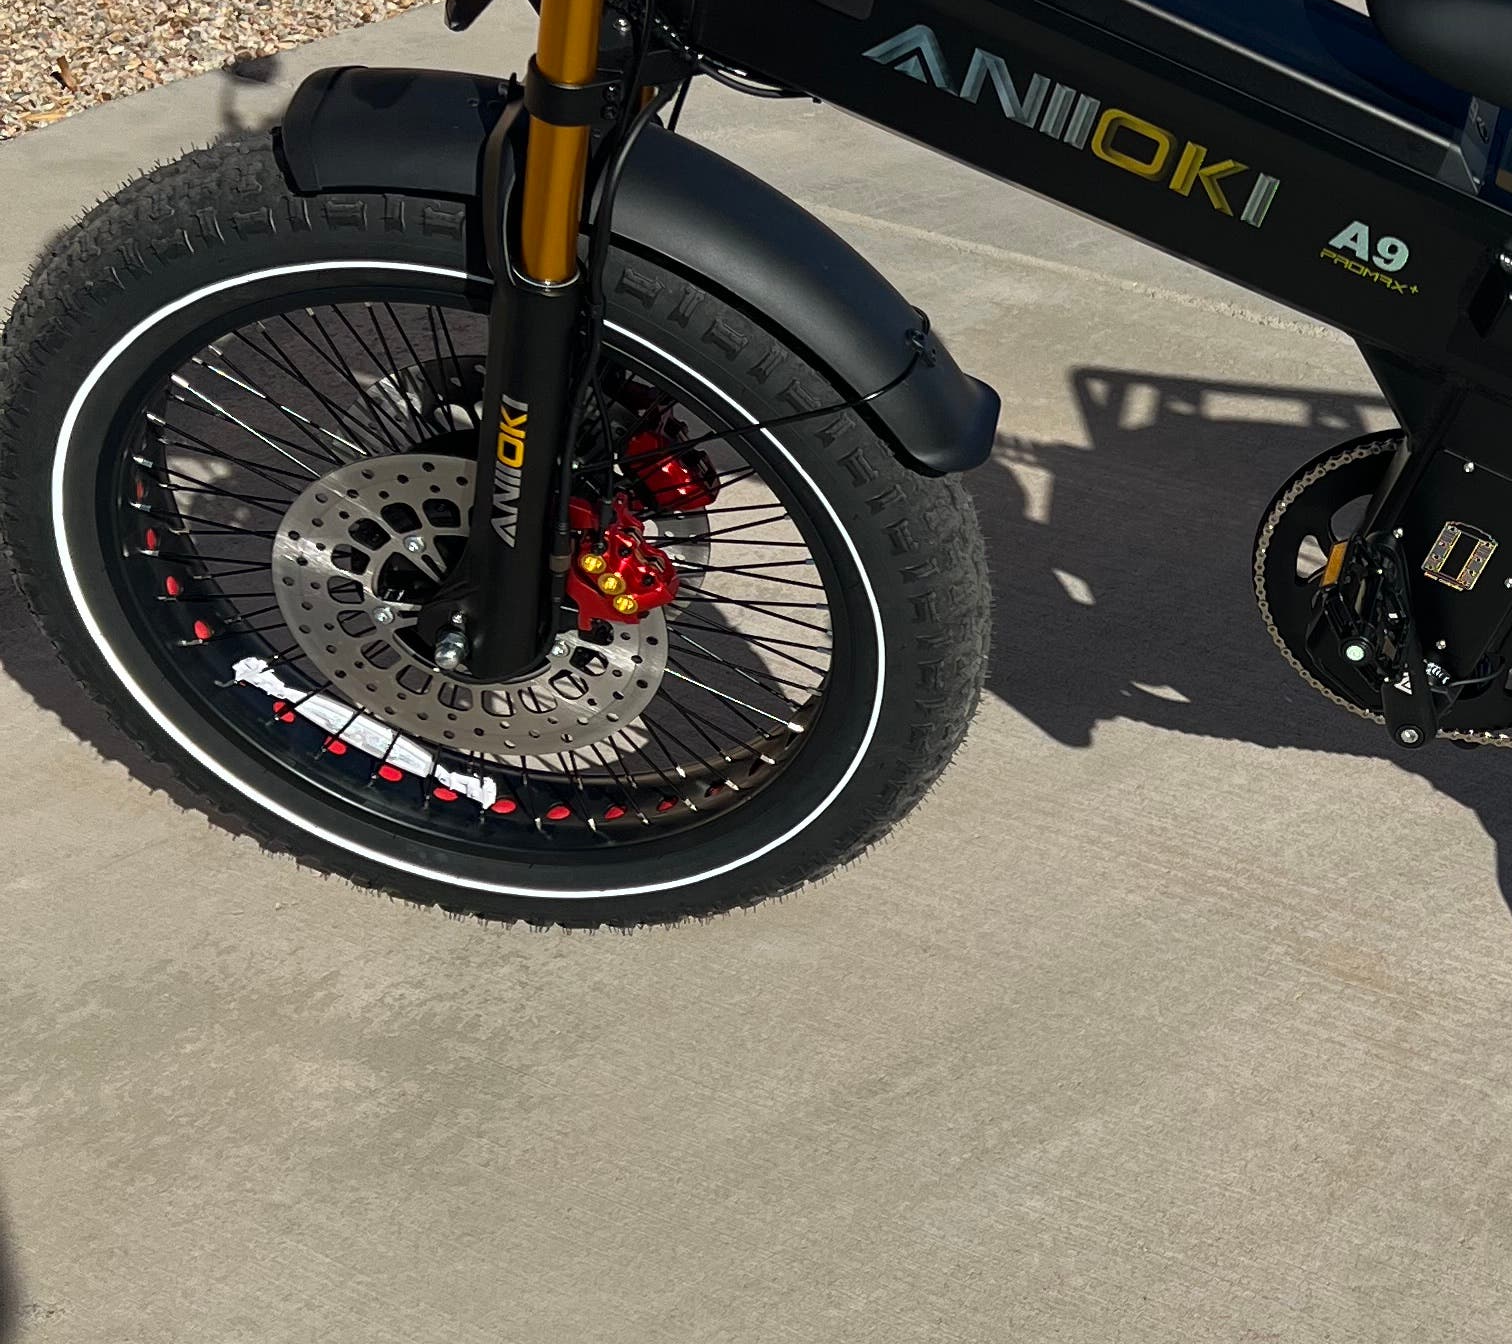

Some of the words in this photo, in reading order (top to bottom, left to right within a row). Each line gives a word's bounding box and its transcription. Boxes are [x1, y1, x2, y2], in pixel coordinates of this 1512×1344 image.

[861, 23, 1281, 228] ANIIOKI
[1328, 220, 1410, 272] A9
[490, 393, 529, 548] ANIIOKI
